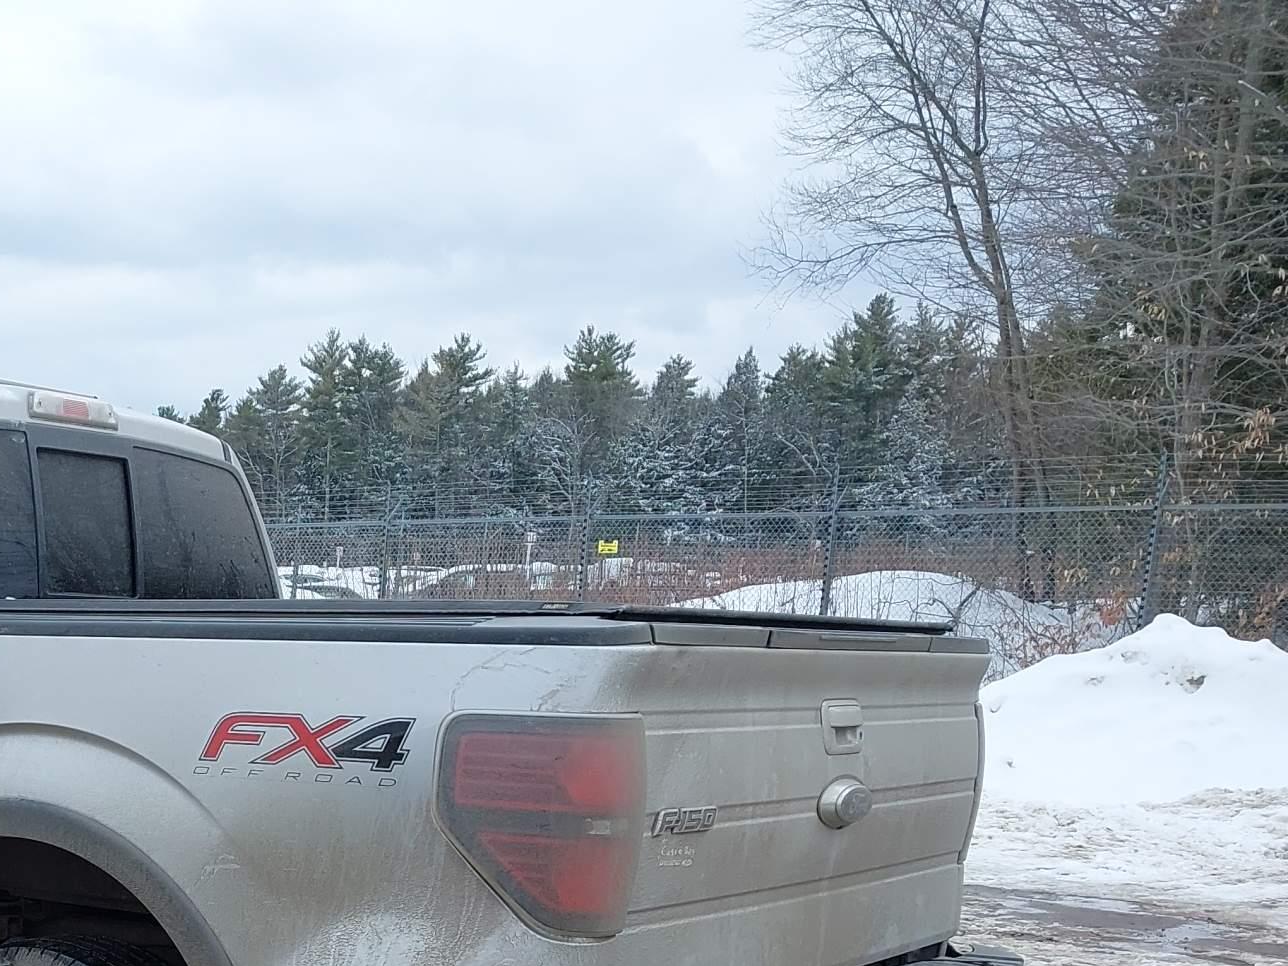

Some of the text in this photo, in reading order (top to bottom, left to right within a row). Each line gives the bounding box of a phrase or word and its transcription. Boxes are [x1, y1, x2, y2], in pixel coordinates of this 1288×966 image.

[199, 711, 416, 772] FX4
[193, 766, 397, 787] OFF ROAD
[652, 806, 718, 837] F-150
